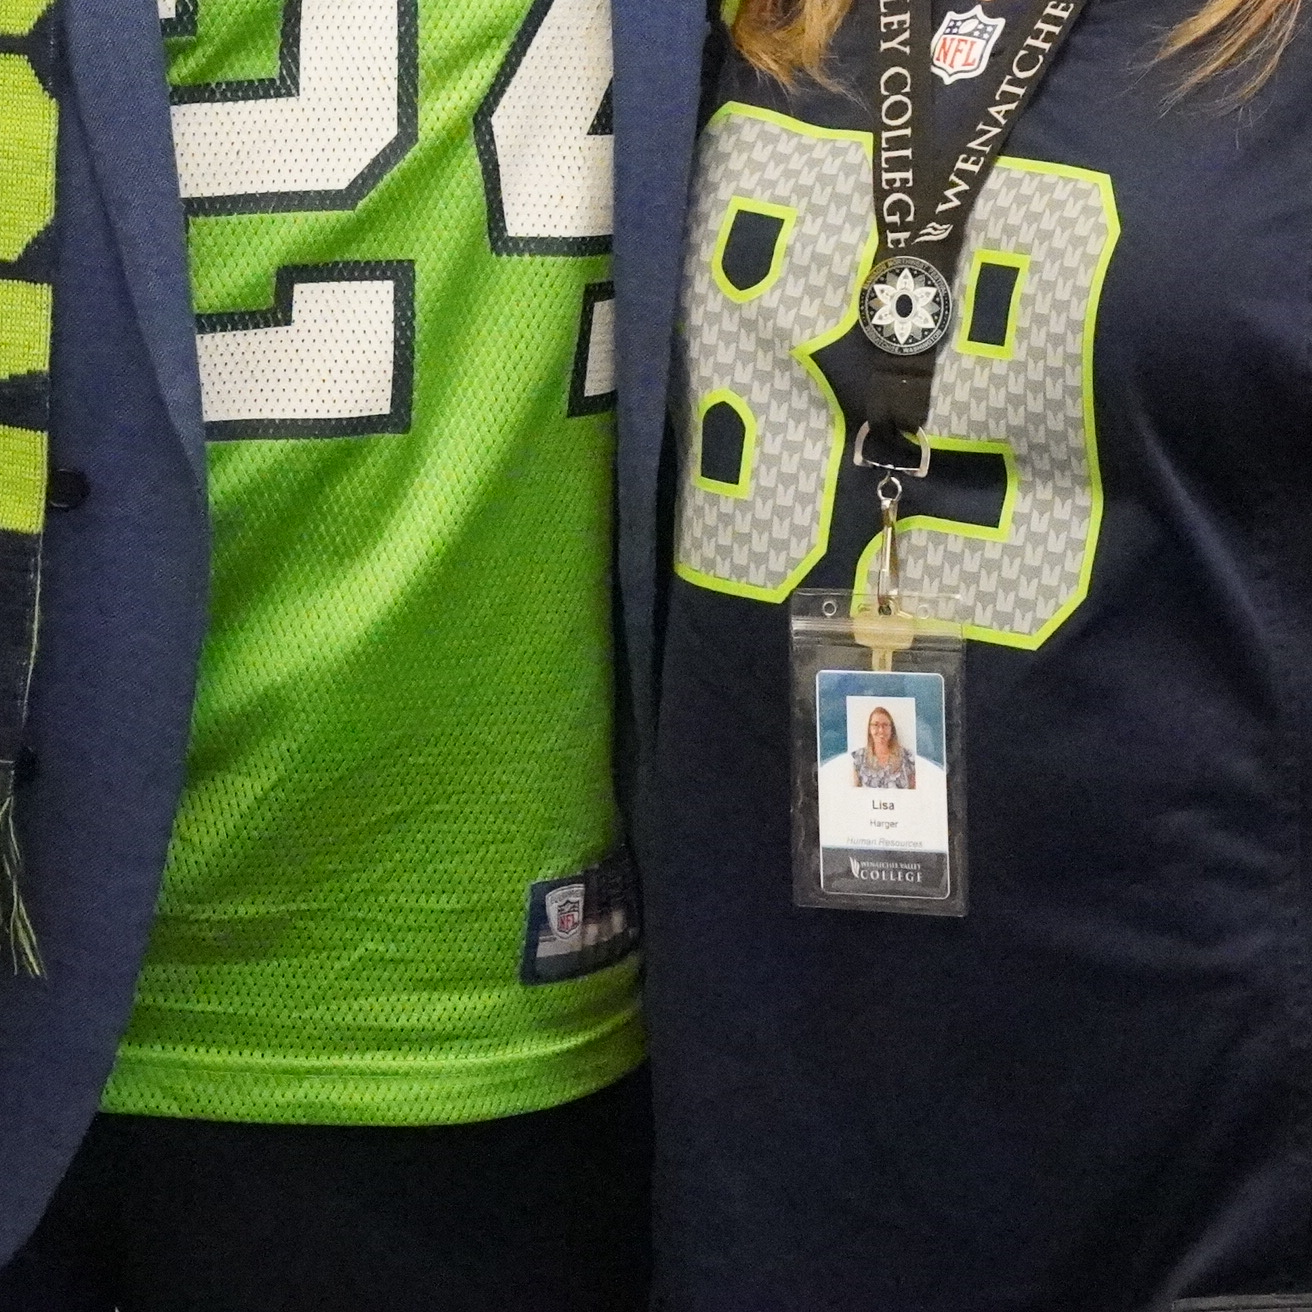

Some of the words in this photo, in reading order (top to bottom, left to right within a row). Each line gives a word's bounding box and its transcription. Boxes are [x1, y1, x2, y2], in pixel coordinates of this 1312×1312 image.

[936, 37, 976, 69] NFL
[880, 66, 915, 249] COLLEGE
[674, 101, 1120, 650] 89
[872, 799, 895, 810] Lisa
